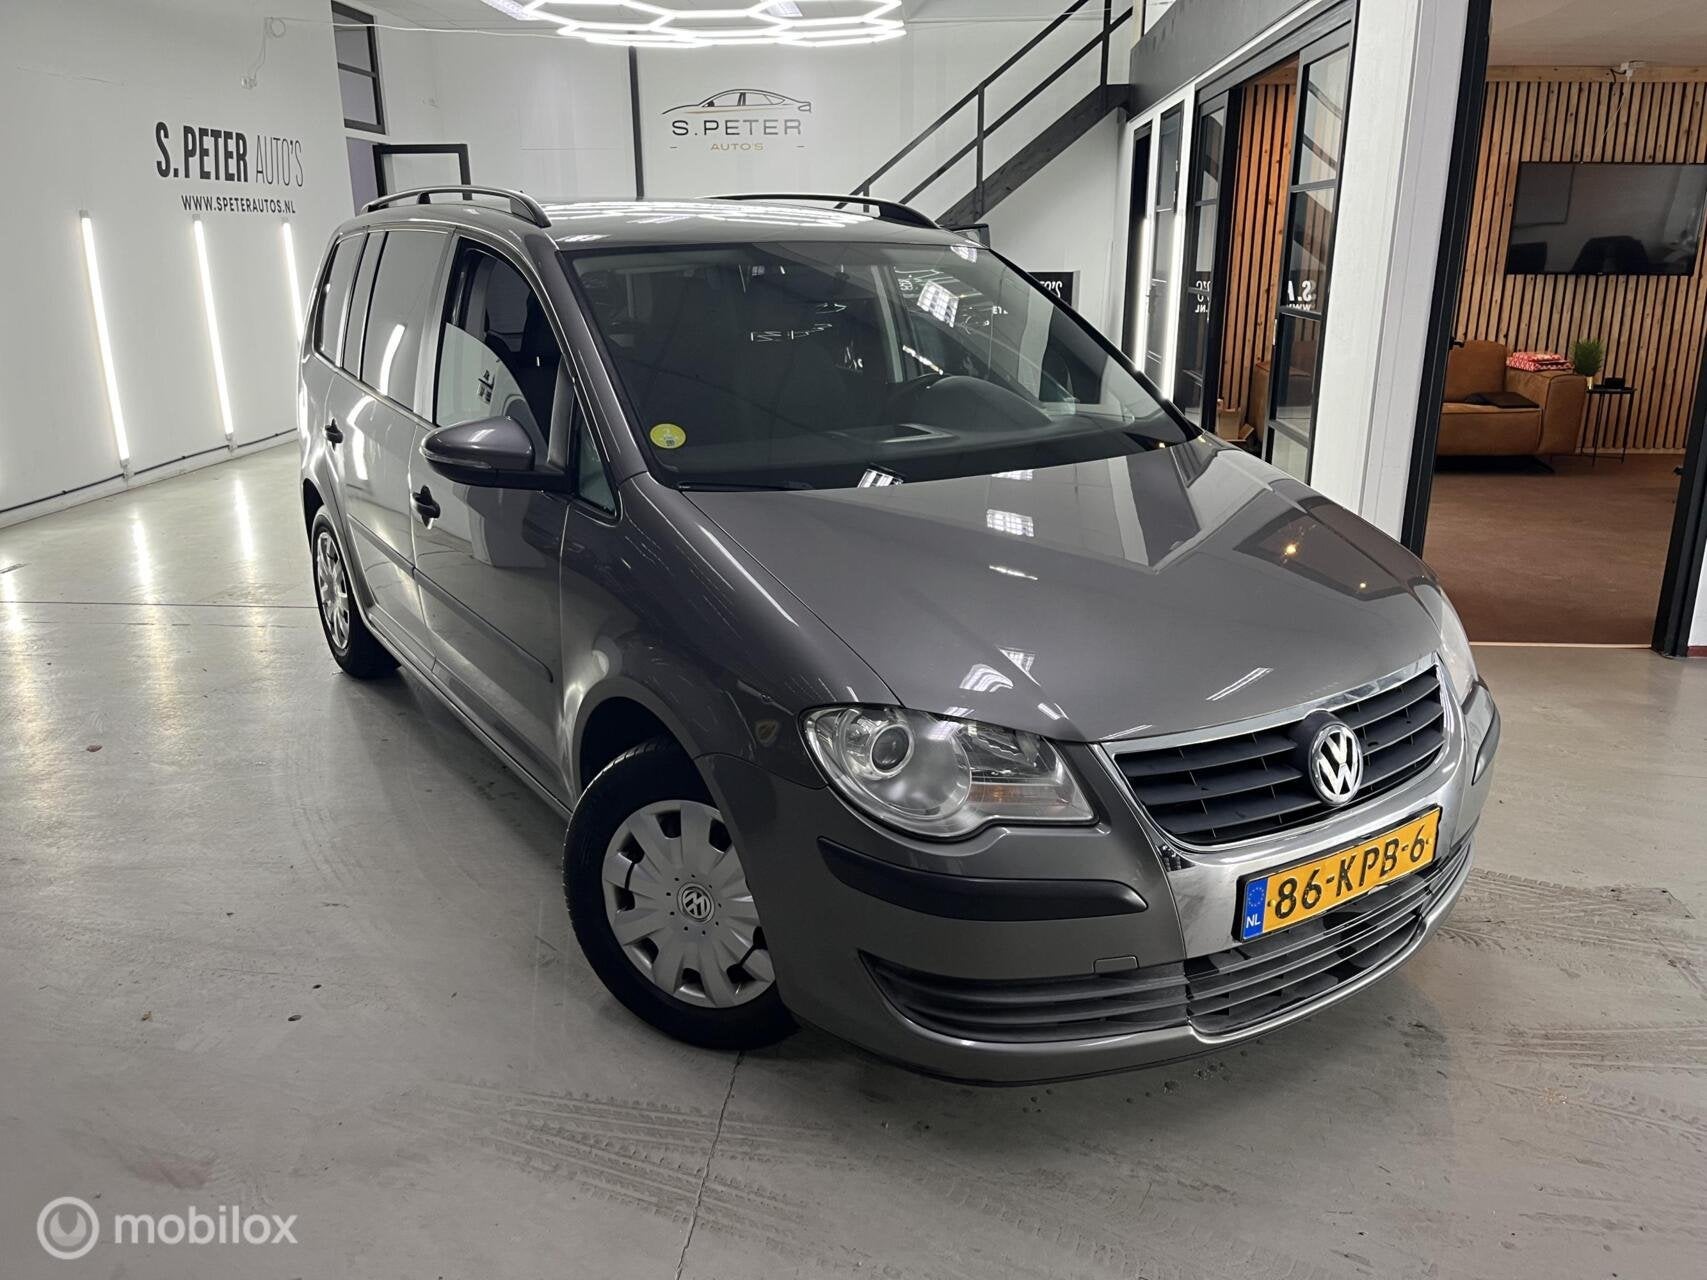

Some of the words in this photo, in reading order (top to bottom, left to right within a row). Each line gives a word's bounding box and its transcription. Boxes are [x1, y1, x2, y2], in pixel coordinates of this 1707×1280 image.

[672, 119, 801, 136] S.PETER
[155, 121, 248, 183] S.PETER
[256, 134, 304, 187] AUTO'S
[181, 195, 296, 214] WWW.SPETERAUTOS.NL
[1275, 825, 1425, 919] 86-KPB-6
[1246, 914, 1261, 929] NL
